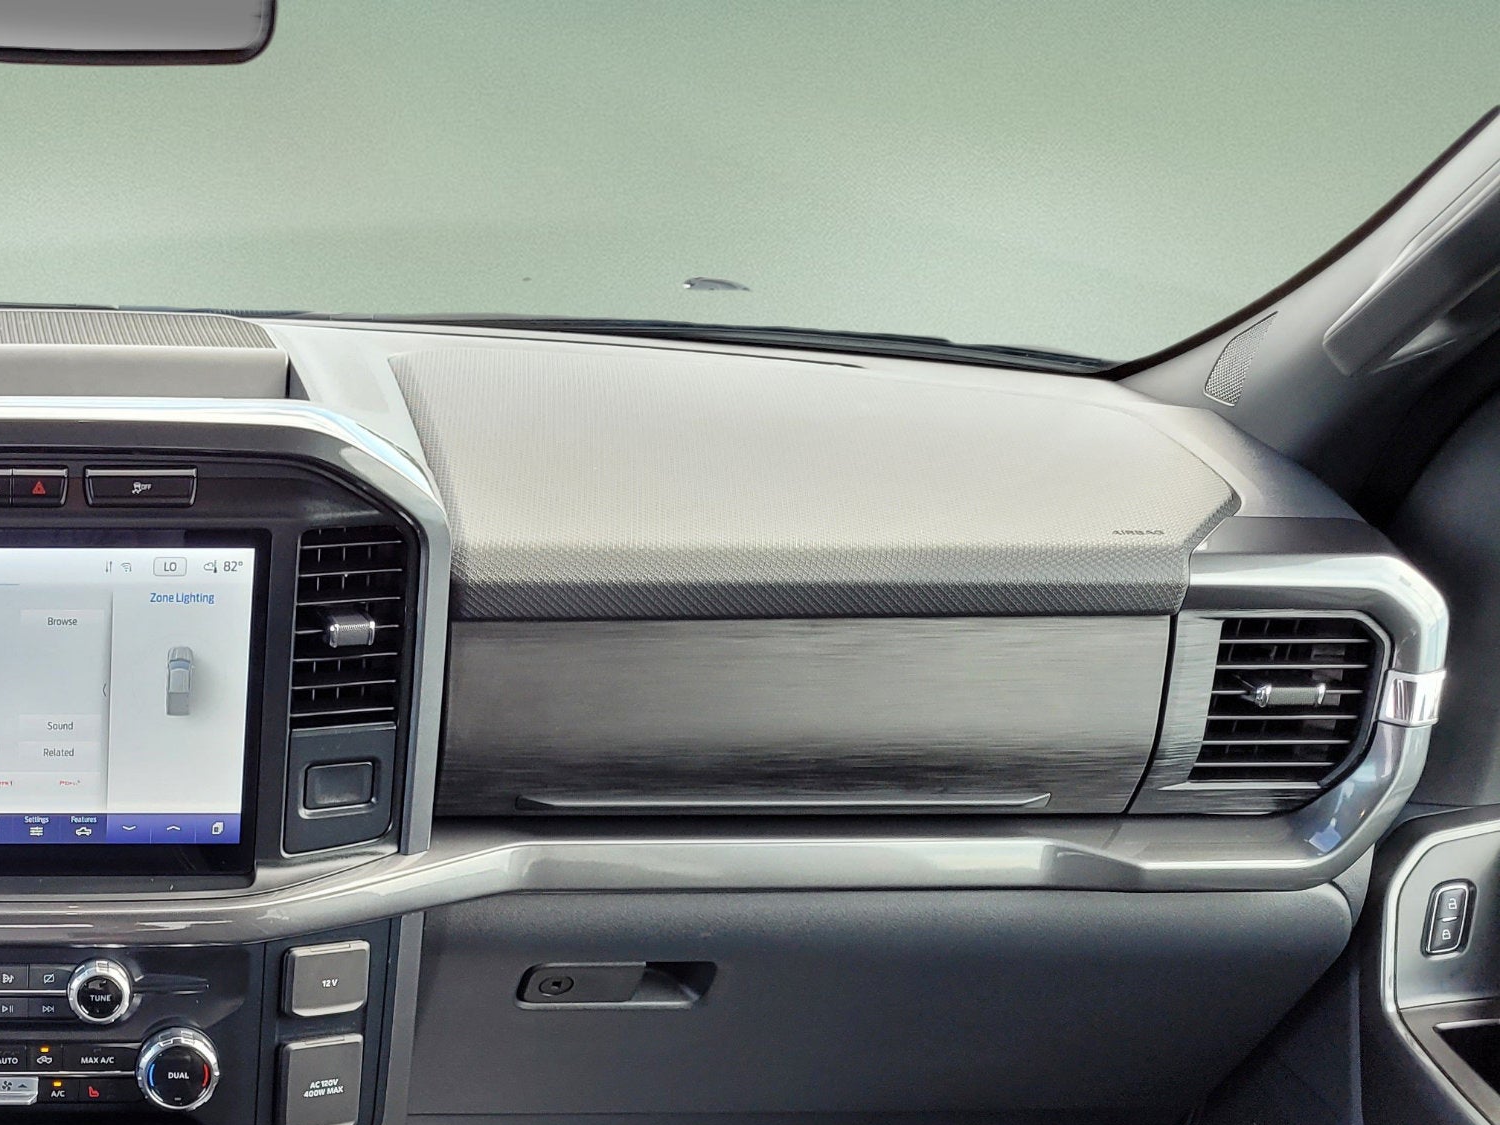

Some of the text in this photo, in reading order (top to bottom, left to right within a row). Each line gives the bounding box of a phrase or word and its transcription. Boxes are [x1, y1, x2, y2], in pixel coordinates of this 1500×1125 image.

[163, 561, 177, 572] LO
[223, 561, 244, 572] 82°
[150, 592, 215, 605] Zone Lighting
[47, 617, 78, 626] Browse
[47, 721, 74, 730] Sound
[43, 748, 75, 757] Related
[24, 816, 49, 824] Settings
[70, 816, 97, 824] Features
[90, 994, 111, 1002] TUNE
[80, 1056, 115, 1064] MAX A/C
[167, 1072, 190, 1080] DUAL
[309, 1079, 339, 1089] AC 120V
[51, 1090, 66, 1098] A/C
[303, 1086, 344, 1098] 400W MAX
